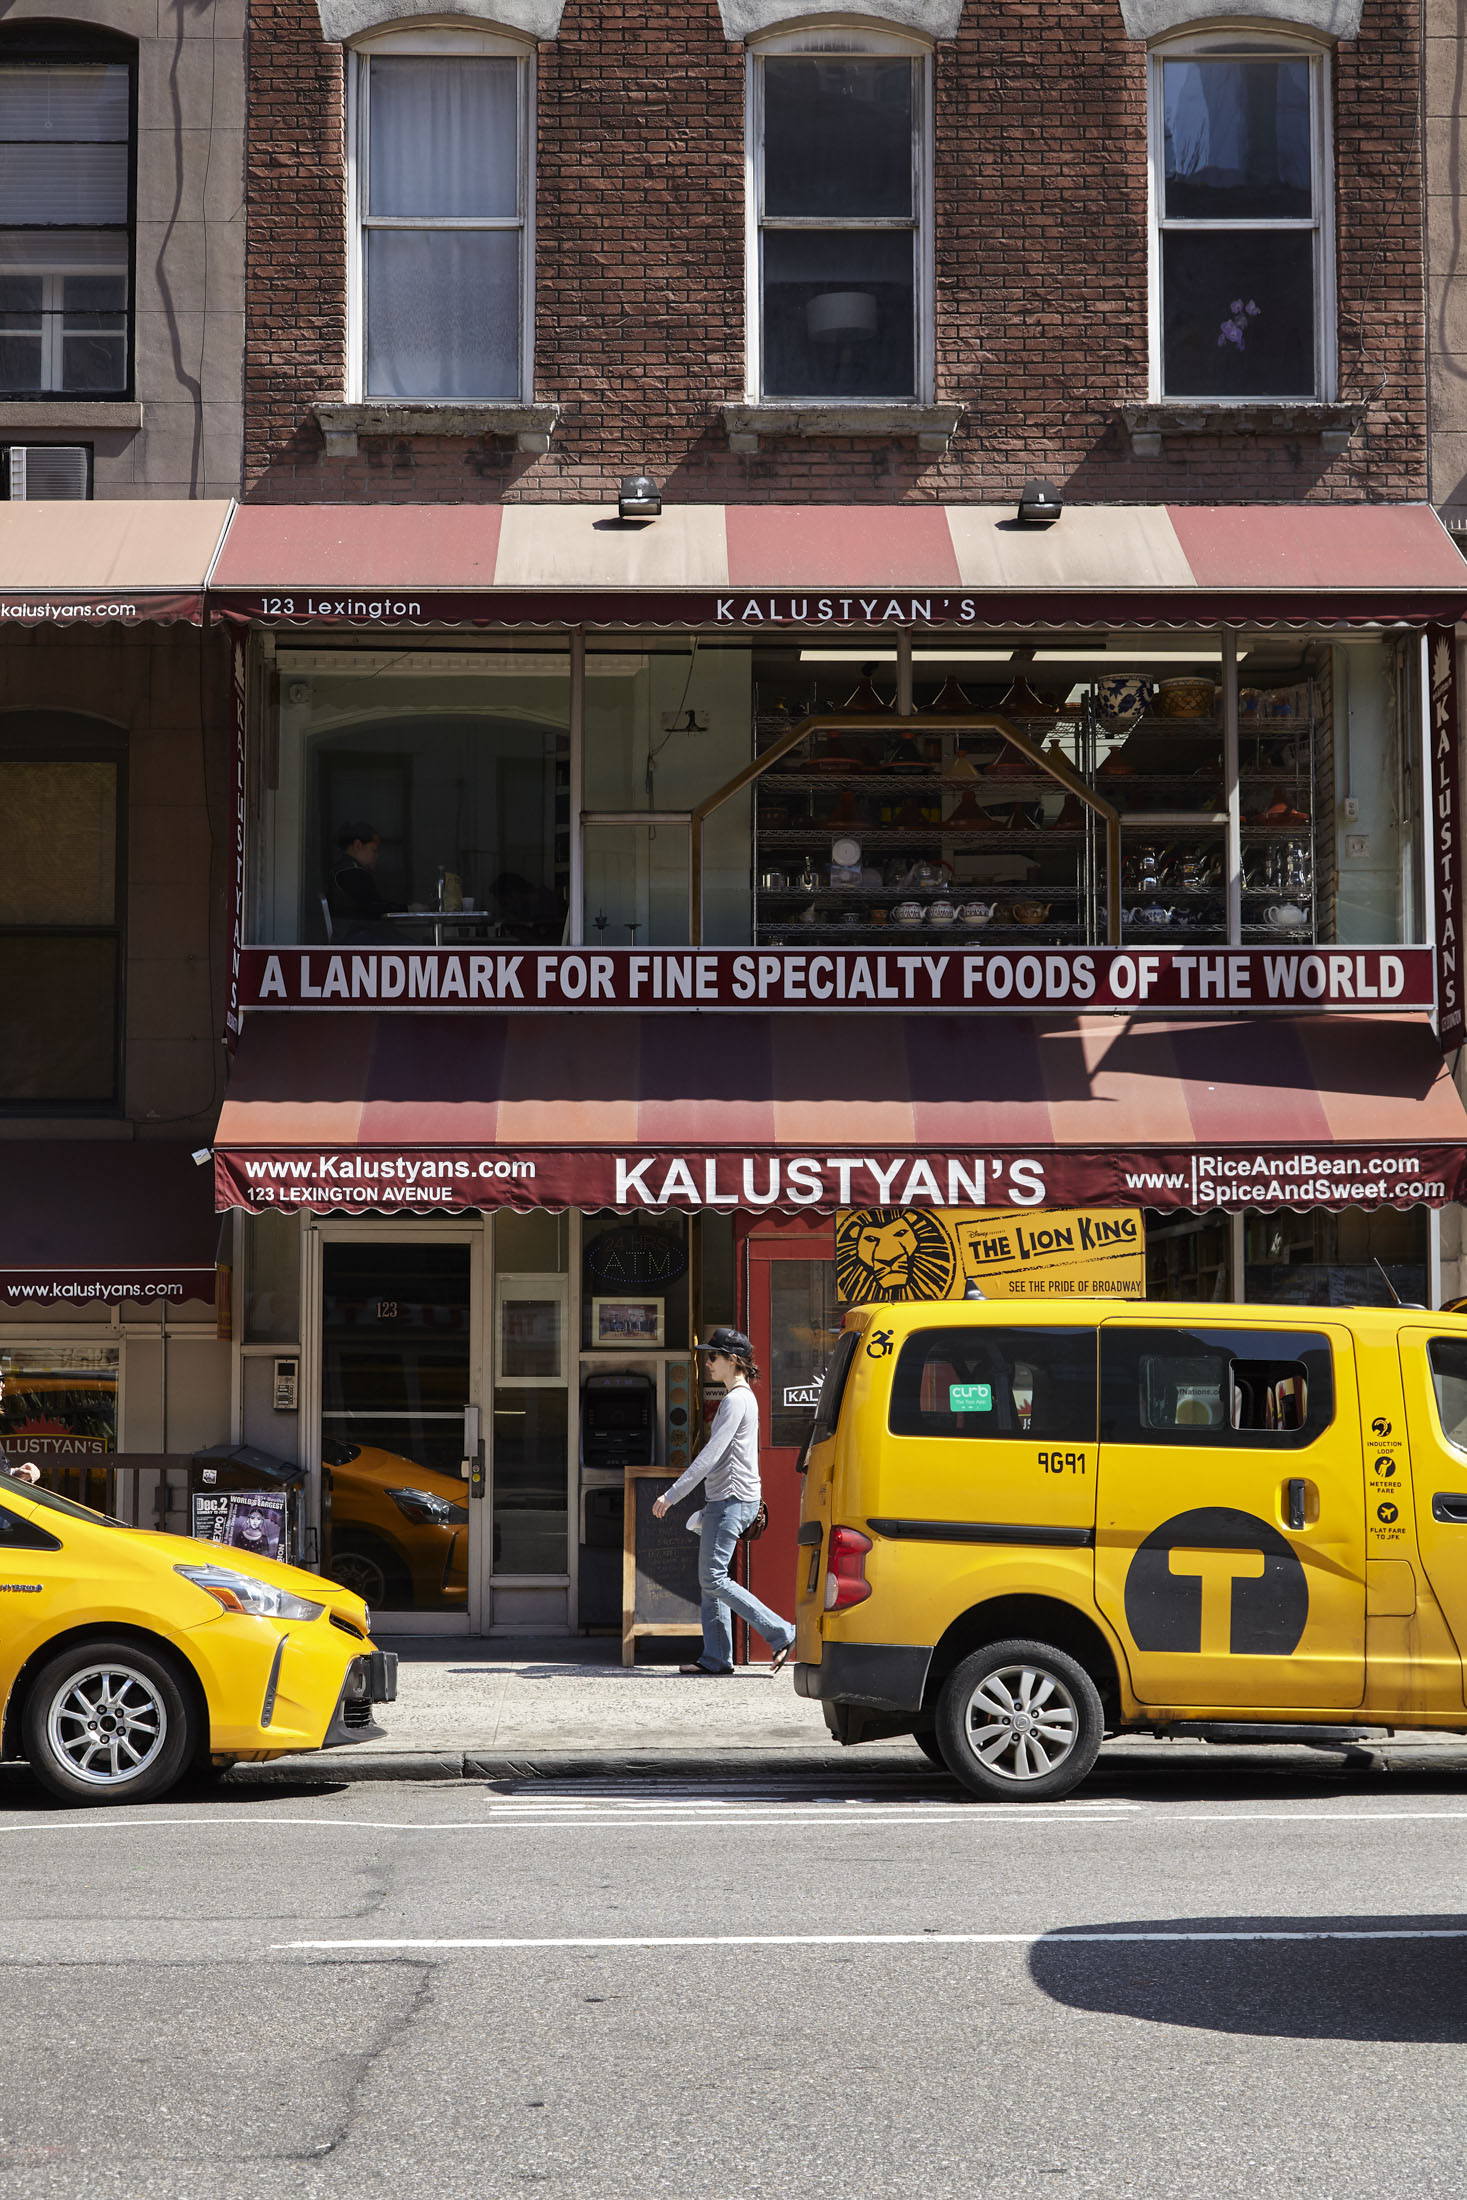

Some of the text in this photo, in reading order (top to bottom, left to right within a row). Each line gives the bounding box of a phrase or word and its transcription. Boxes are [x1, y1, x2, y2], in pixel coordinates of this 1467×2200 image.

[0, 603, 136, 619] kalustyans.com
[261, 598, 421, 619] 123 Lexington
[716, 599, 976, 620] KALUSTYAN'S
[1435, 694, 1456, 1008] KALUSTYANS
[259, 955, 1405, 999] A LANDMARK FOR FINE SPECIALTY FOODS OF THE WORLD
[245, 1156, 536, 1183] www.Kalustyans.com
[1199, 1155, 1420, 1177] RiceAndBean.com
[615, 1158, 1045, 1206] KALUSTYAN'S
[1125, 1173, 1190, 1189] www.
[1199, 1178, 1446, 1205] SpiceAndSweet.com
[247, 1187, 453, 1201] 123 LEXINGTON AVENUE
[968, 1217, 1137, 1259] THE LION KING
[603, 1251, 670, 1275] ATM
[7, 1282, 183, 1300] www.kalustyans.com
[1009, 1281, 1141, 1293] SEE THE PRIDE OF BROADWAY
[377, 1301, 398, 1318] 123
[952, 1385, 989, 1398] curb
[1038, 1452, 1086, 1475] 9G91
[197, 1497, 228, 1511] Dec.2
[258, 1499, 284, 1510] LARGEST
[213, 1516, 225, 1543] EXPO
